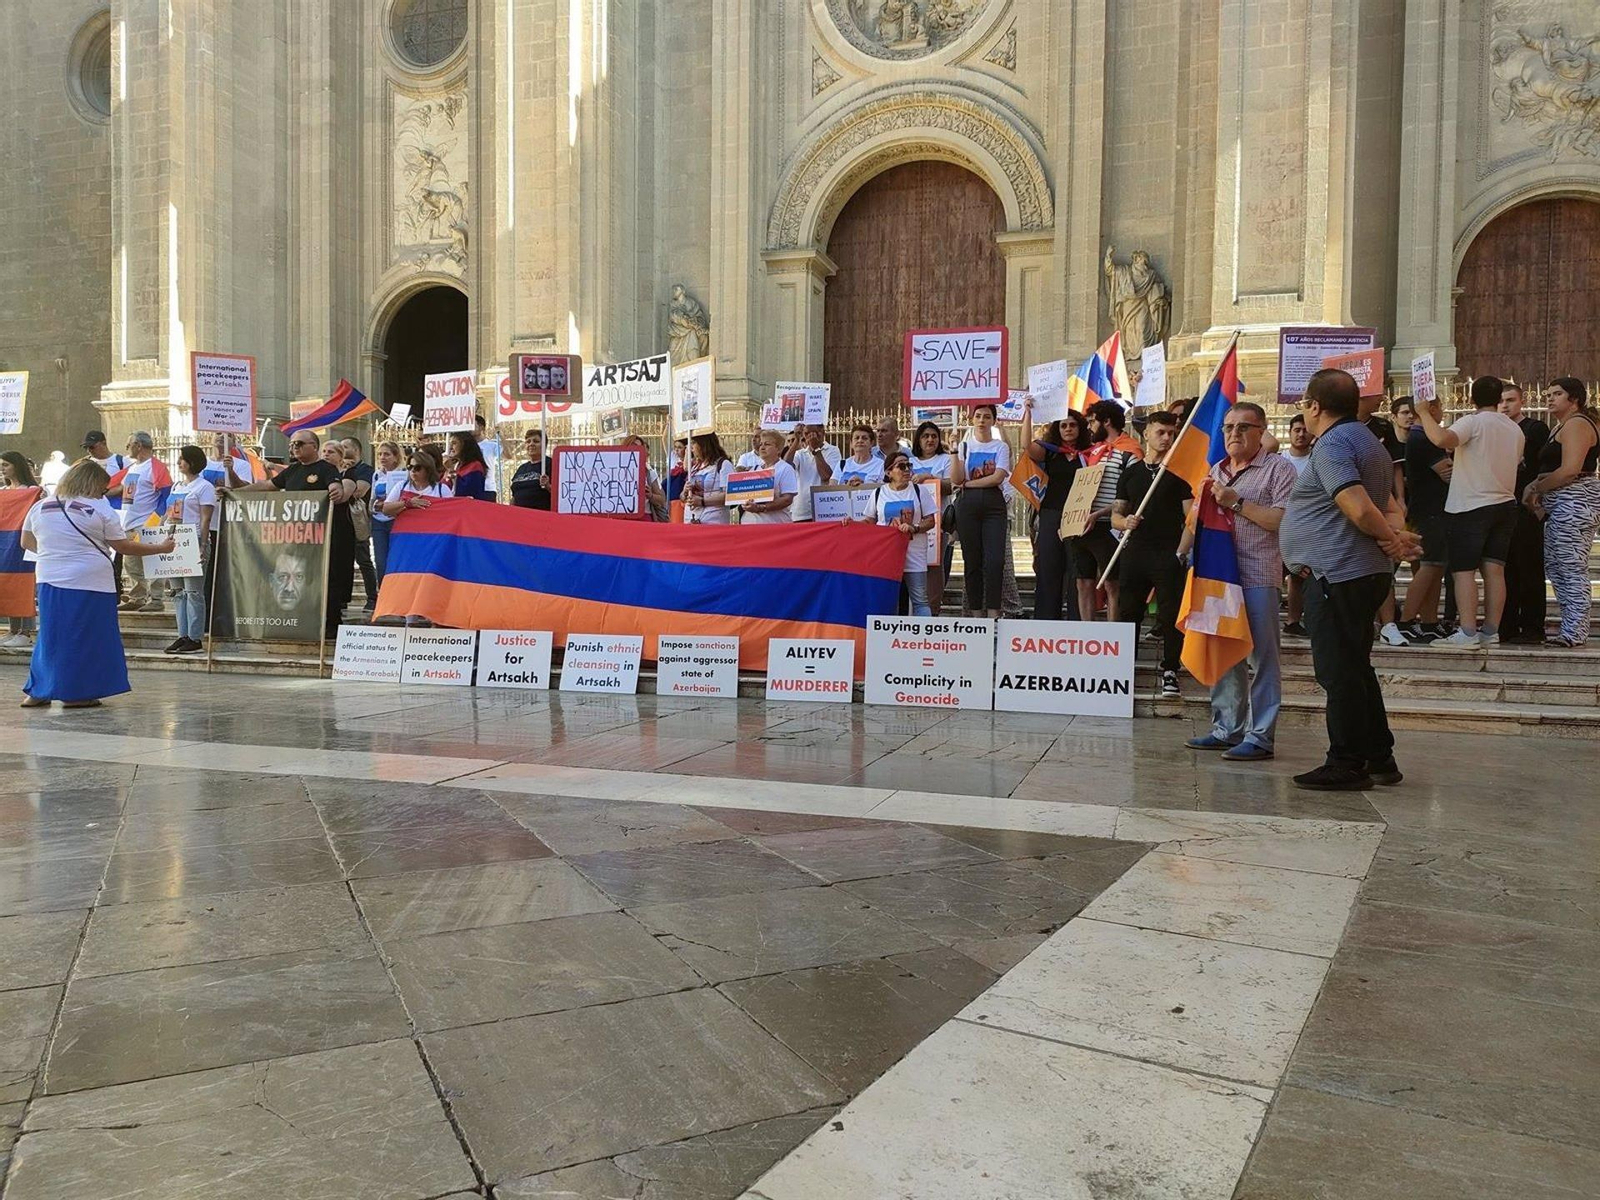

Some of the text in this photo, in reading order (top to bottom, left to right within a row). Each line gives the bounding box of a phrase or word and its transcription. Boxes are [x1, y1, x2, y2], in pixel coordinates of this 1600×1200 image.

[922, 338, 986, 362] SAVE
[198, 363, 247, 373] International
[587, 355, 667, 387] ARTSAJ
[197, 372, 249, 381] peacekeepers
[912, 367, 1000, 392] ARTSAKH
[213, 380, 243, 388] Artsakh
[425, 376, 474, 399] SANCTION
[205, 405, 235, 413] Prisoners
[216, 399, 248, 407] Armenian
[207, 419, 242, 427] Azerbaijan
[424, 406, 474, 427] AZERBAIJAN
[565, 450, 638, 469] NO A LA
[568, 466, 634, 483] INVASION
[561, 480, 640, 499] DE ARMENIA
[225, 499, 320, 521] WE WILL STOP
[1063, 508, 1090, 525] PUTIN
[142, 528, 157, 536] Free
[261, 522, 324, 544] ERDOGAN
[182, 539, 190, 547] of
[154, 567, 193, 576] Azerbaijan
[235, 616, 252, 625] BEFORE
[266, 617, 282, 626] TOO
[282, 618, 299, 627] LATE
[873, 620, 987, 635] Buying gas from
[358, 630, 387, 638] demand
[409, 635, 472, 646] International
[494, 633, 537, 646] Justice
[567, 641, 641, 654] Punish ethnic
[661, 640, 736, 650] Impose sanctions
[890, 638, 967, 653] Azerbaijan
[1011, 637, 1120, 656] SANCTION
[404, 651, 473, 664] peacekeepers
[504, 651, 524, 664] for
[785, 646, 837, 659] ALIYEV
[352, 656, 388, 664] Armenians
[568, 658, 634, 673] cleansing in
[658, 654, 738, 666] against aggressor
[922, 657, 935, 667] =
[411, 668, 462, 679] in Artsakh
[680, 669, 715, 678] state of
[804, 665, 816, 674] =
[487, 670, 538, 684] Artsakh
[575, 676, 621, 688] Artsakh
[884, 673, 972, 690] Complicity in
[672, 683, 721, 695] Azerbaijan
[770, 679, 849, 693] MURDERER
[999, 674, 1130, 695] AZERBAIJAN
[895, 691, 960, 706] Genocide
